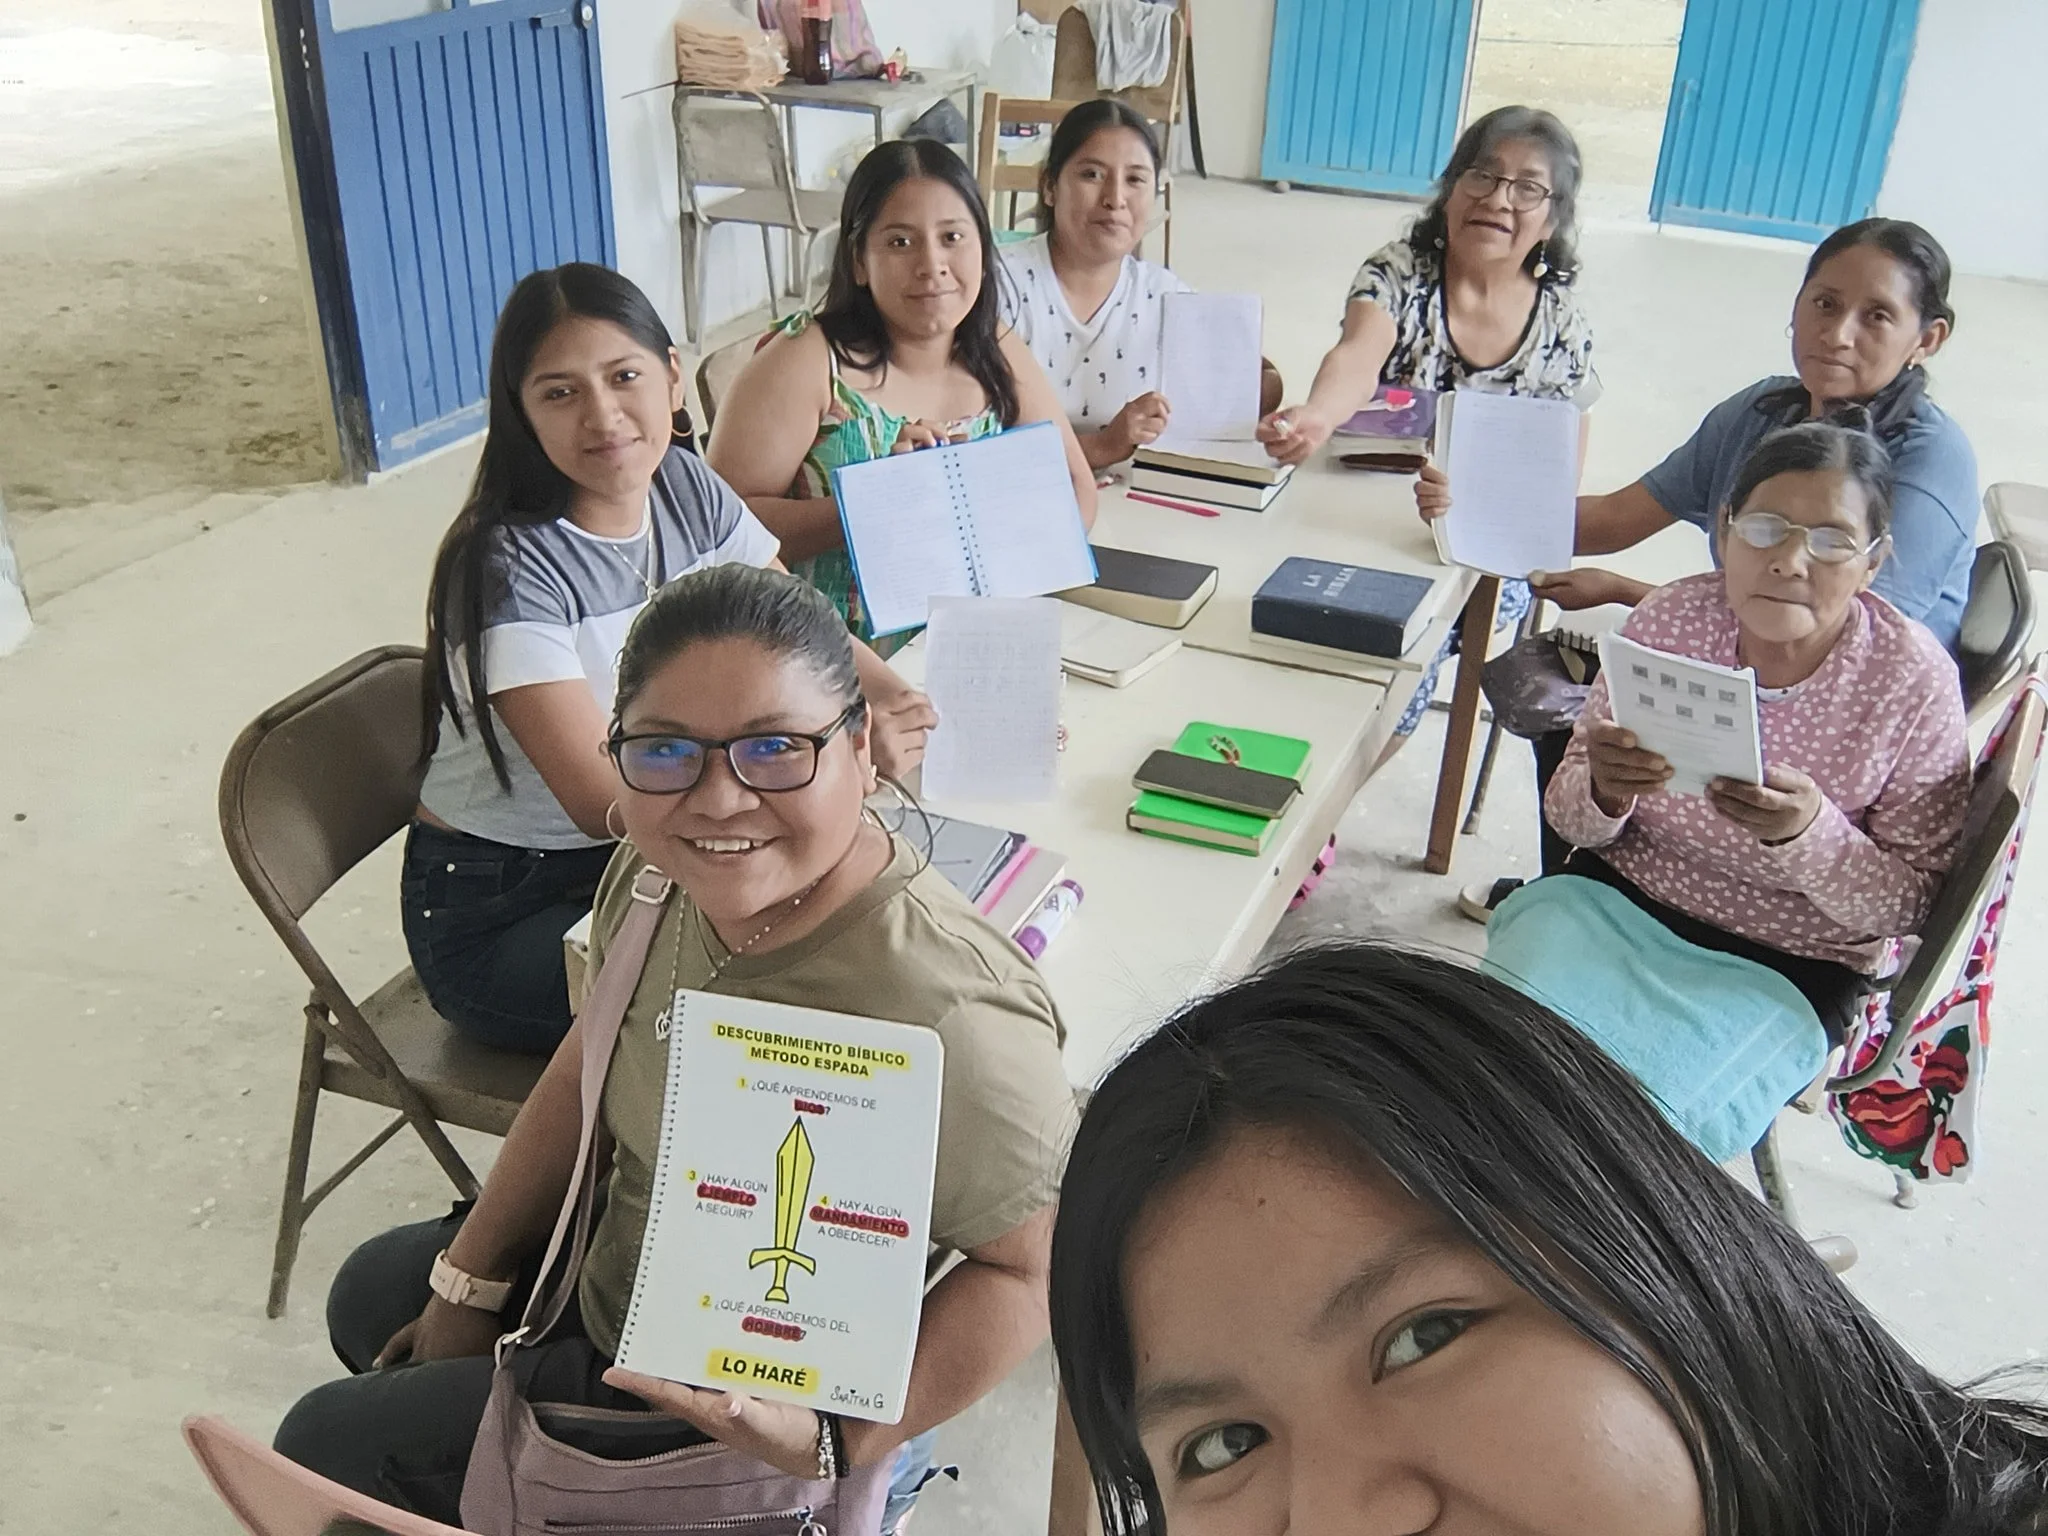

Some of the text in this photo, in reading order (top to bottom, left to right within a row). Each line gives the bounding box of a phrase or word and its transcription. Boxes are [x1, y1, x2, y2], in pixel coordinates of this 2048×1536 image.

[717, 1025, 905, 1066] DESCUBRIMIENTO BÍBLICO
[814, 1057, 869, 1076] ESPADA
[781, 1084, 858, 1106] APRENDEMOS
[861, 1098, 876, 1110] DE
[695, 1201, 754, 1220] A SEGUIR?
[812, 1208, 907, 1235] MANDAMIENTO
[818, 1225, 897, 1248] A OBEDECER?
[746, 1304, 826, 1328] APRENDEMOS
[829, 1319, 851, 1334] DEL
[721, 1356, 807, 1387] LO HARÉ
[873, 1392, 883, 1409] G
